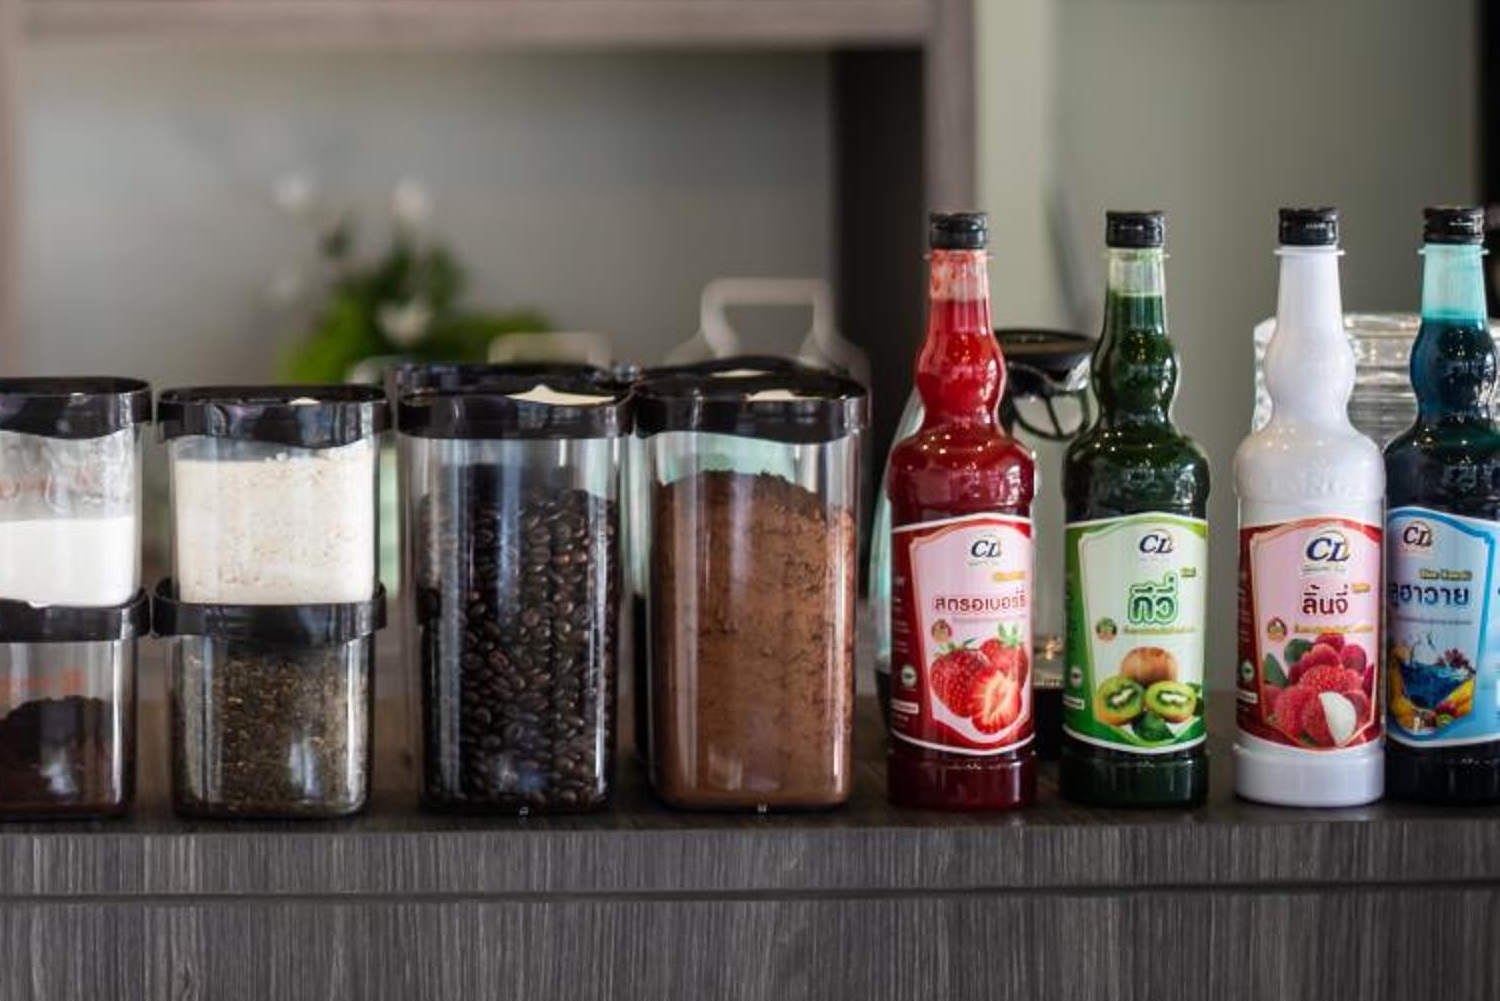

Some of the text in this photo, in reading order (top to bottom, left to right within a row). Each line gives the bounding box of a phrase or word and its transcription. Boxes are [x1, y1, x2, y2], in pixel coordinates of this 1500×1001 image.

[1139, 534, 1174, 555] CL
[1403, 526, 1434, 548] CL
[970, 539, 1003, 559] CL
[1305, 537, 1351, 562] CL
